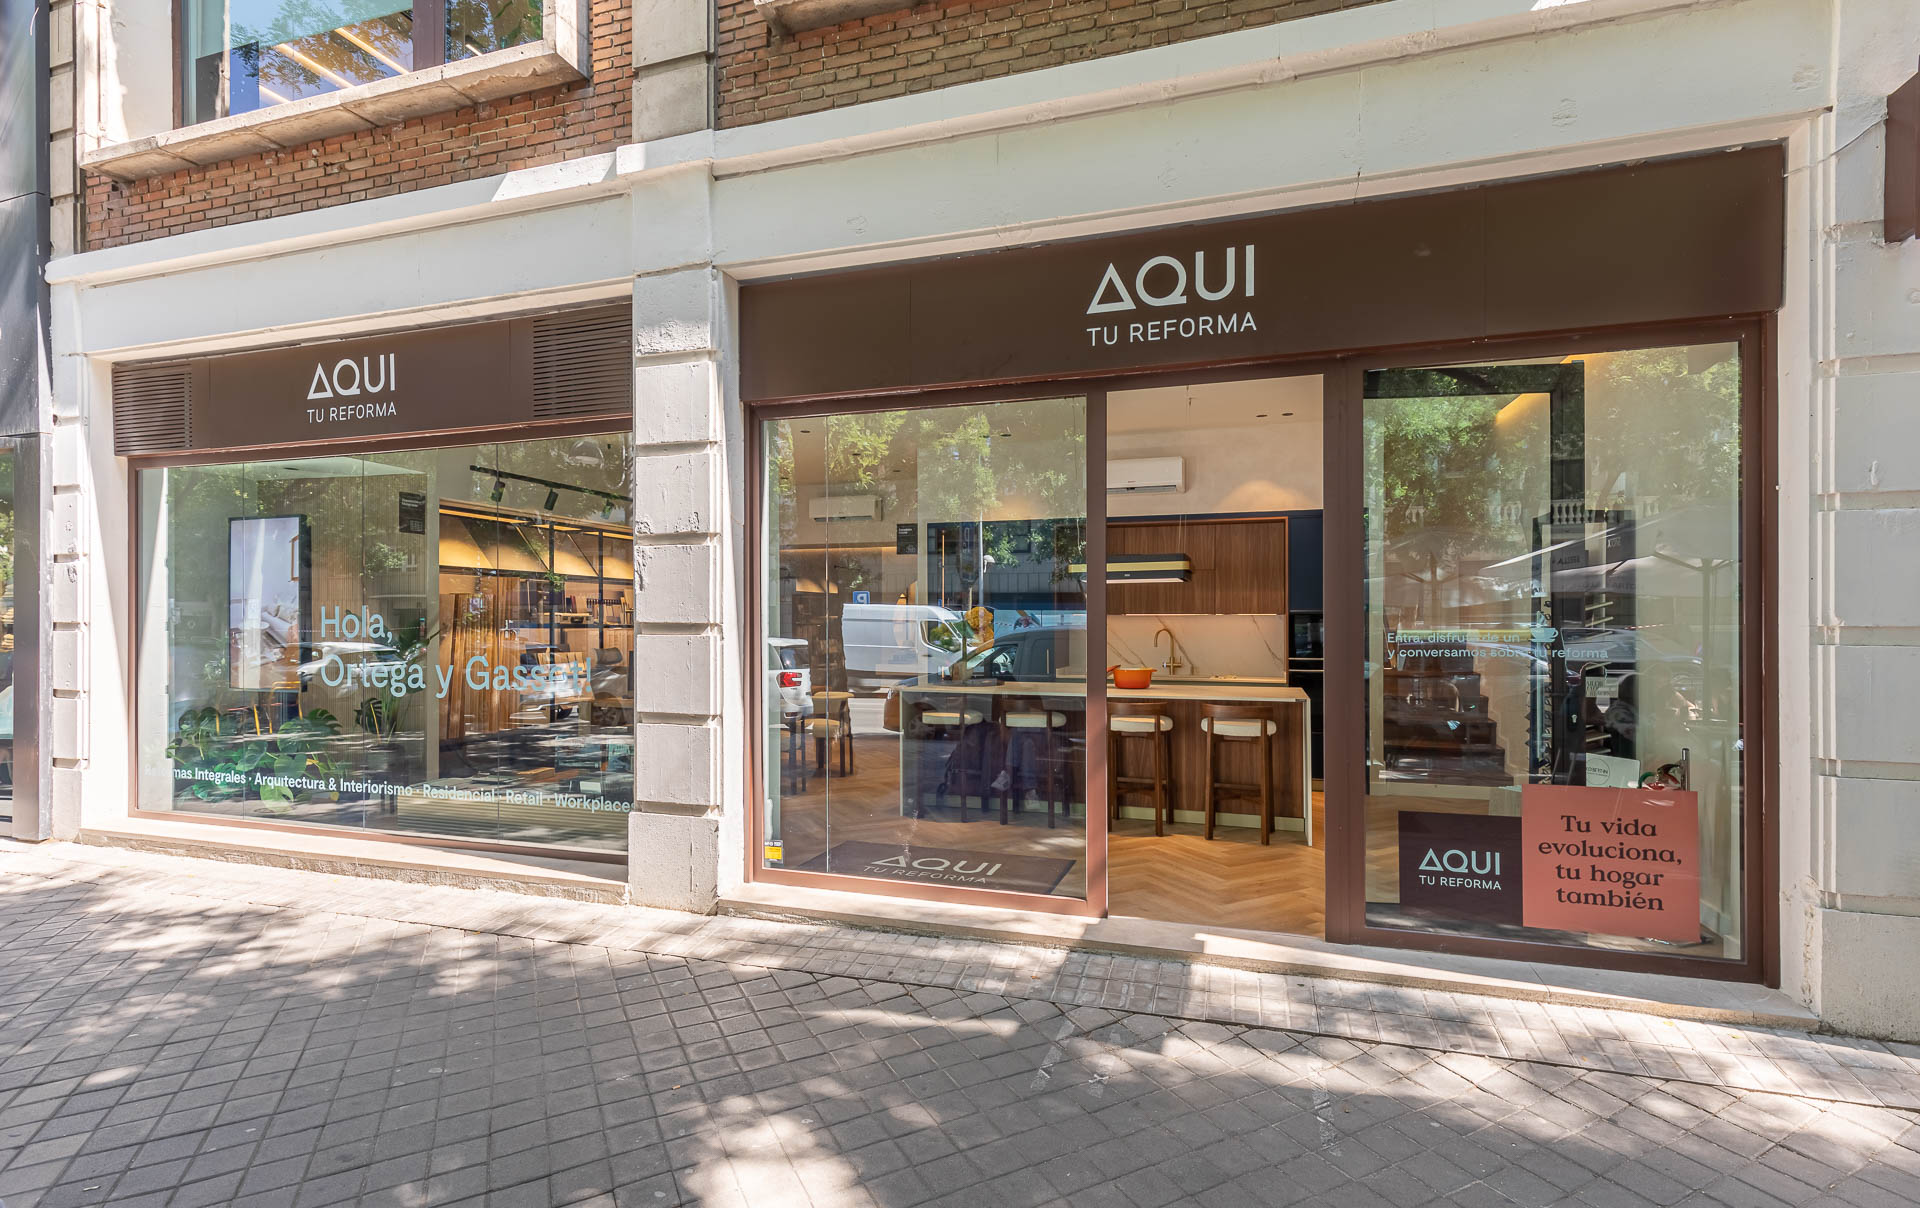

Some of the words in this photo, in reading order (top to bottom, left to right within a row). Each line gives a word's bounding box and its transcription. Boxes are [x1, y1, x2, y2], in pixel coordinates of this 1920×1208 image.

[1086, 244, 1255, 315] AQUI
[1086, 325, 1118, 347] TU
[1129, 311, 1257, 343] REFORMA
[306, 353, 396, 400] AQUI
[306, 408, 324, 424] TU
[329, 401, 397, 422] REFORMA
[320, 604, 393, 643] Hola,
[1428, 631, 1479, 643] disfru
[1503, 633, 1520, 643] un
[1387, 650, 1395, 660] y
[1399, 649, 1487, 658] conversamos
[1551, 647, 1609, 658] reforma
[320, 653, 426, 698] Ortega
[435, 663, 454, 699] y
[195, 767, 246, 784] Integrales
[254, 772, 326, 789] Arquitectura
[328, 777, 337, 791] &
[340, 778, 413, 796] Interiorismo
[422, 783, 495, 802] Residencial
[506, 789, 543, 807] Retail
[1560, 815, 1591, 833] Tu
[1600, 817, 1658, 837] vida
[1418, 847, 1500, 876] AQUI
[1538, 840, 1682, 865] evoluciona,
[863, 865, 888, 873] TU
[891, 869, 986, 884] REFORMA
[871, 855, 1002, 876] AQUI
[1555, 863, 1582, 880] tu
[1590, 864, 1664, 889] hogar
[1418, 875, 1435, 886] TU
[1440, 876, 1502, 891] REFORMA
[1556, 887, 1665, 911] también
